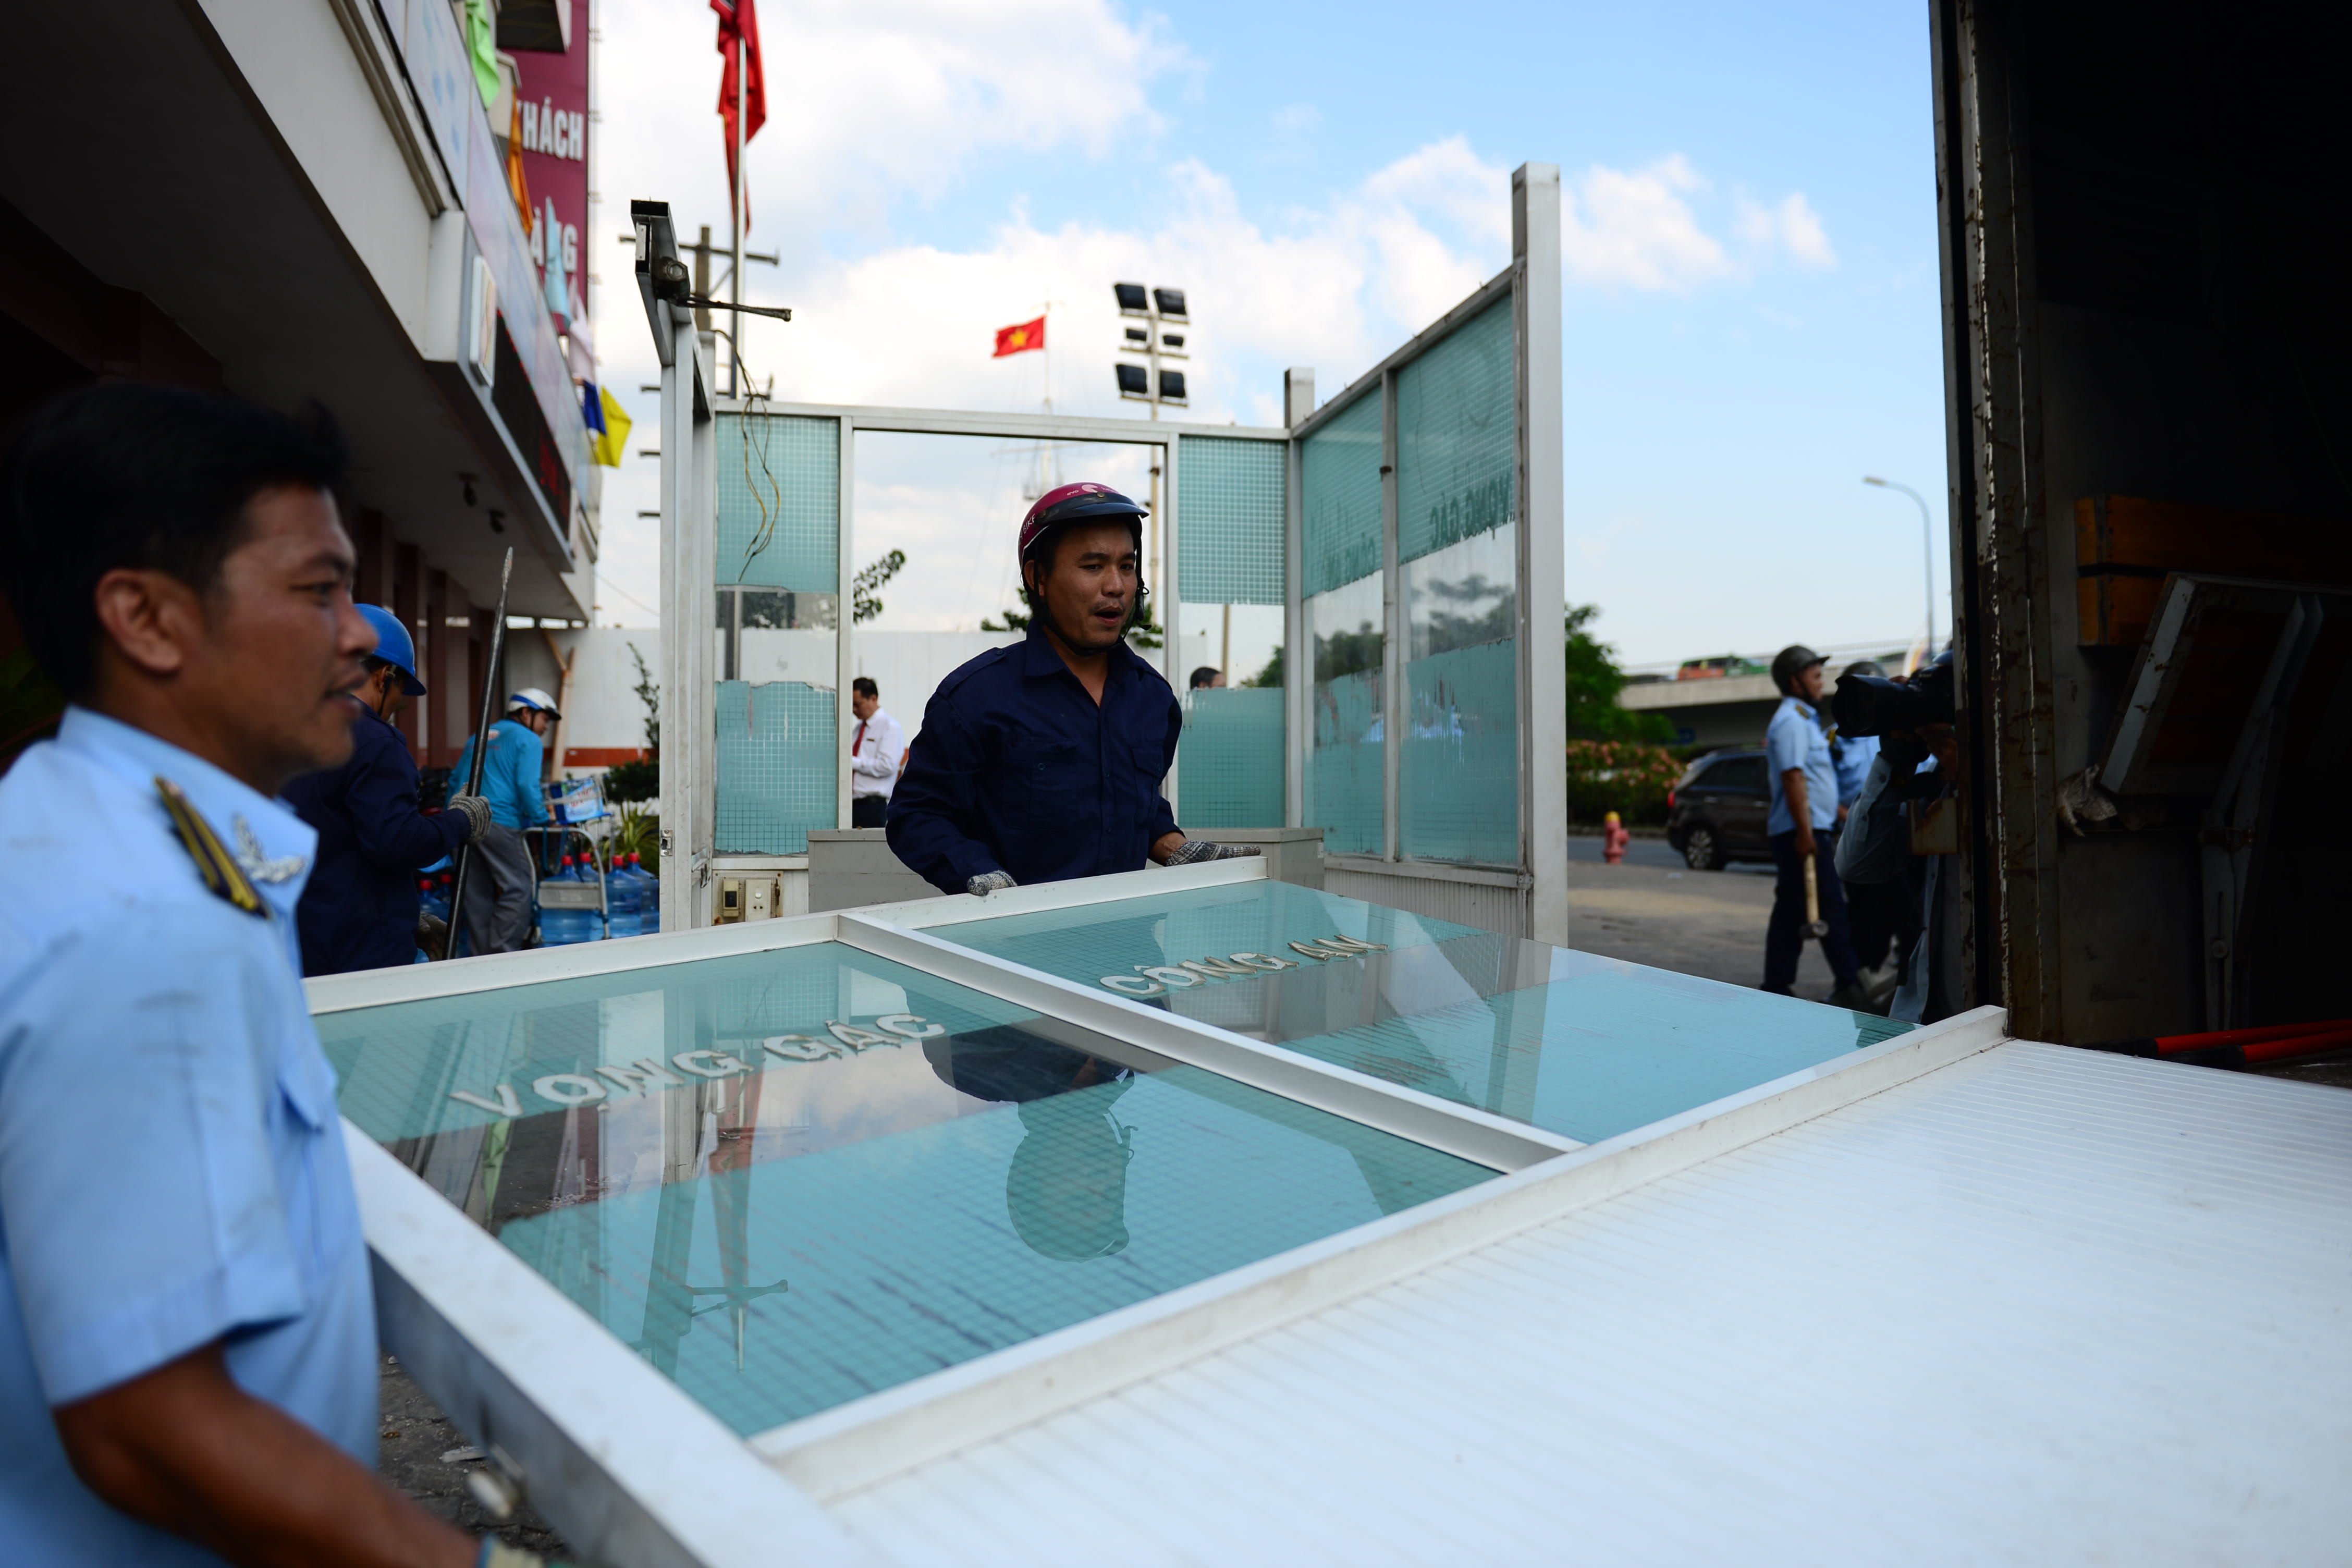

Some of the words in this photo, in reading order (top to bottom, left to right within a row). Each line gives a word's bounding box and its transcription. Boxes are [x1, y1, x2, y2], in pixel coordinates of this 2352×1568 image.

[518, 96, 582, 160] HÁCH
[1287, 934, 1389, 961] AN
[449, 1049, 755, 1119] VỌNG
[762, 1013, 947, 1062] GÁC
